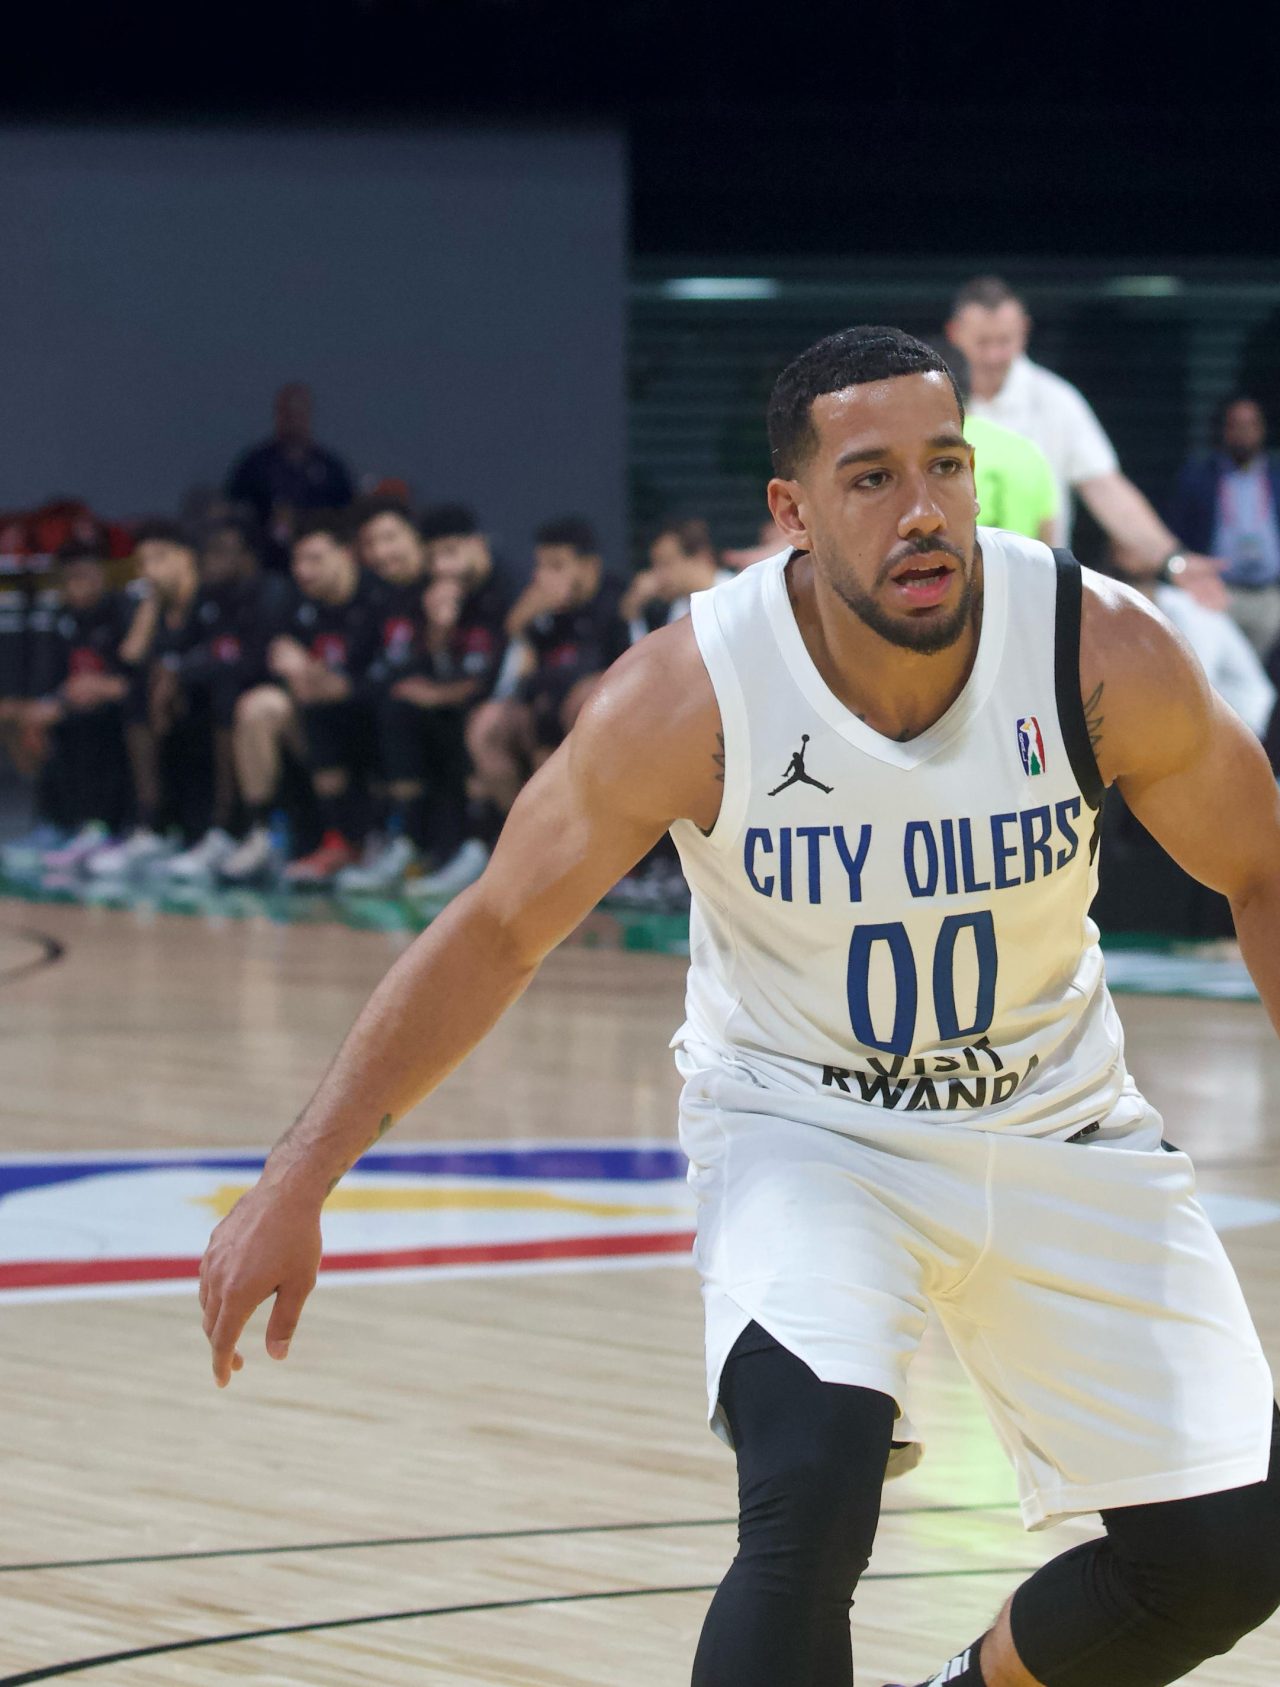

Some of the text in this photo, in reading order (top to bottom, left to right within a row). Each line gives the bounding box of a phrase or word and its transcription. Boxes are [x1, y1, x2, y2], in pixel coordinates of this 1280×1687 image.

[744, 795, 1081, 904] CITY OILERS
[847, 910, 998, 1057] 00
[866, 1036, 1004, 1078] VISIT
